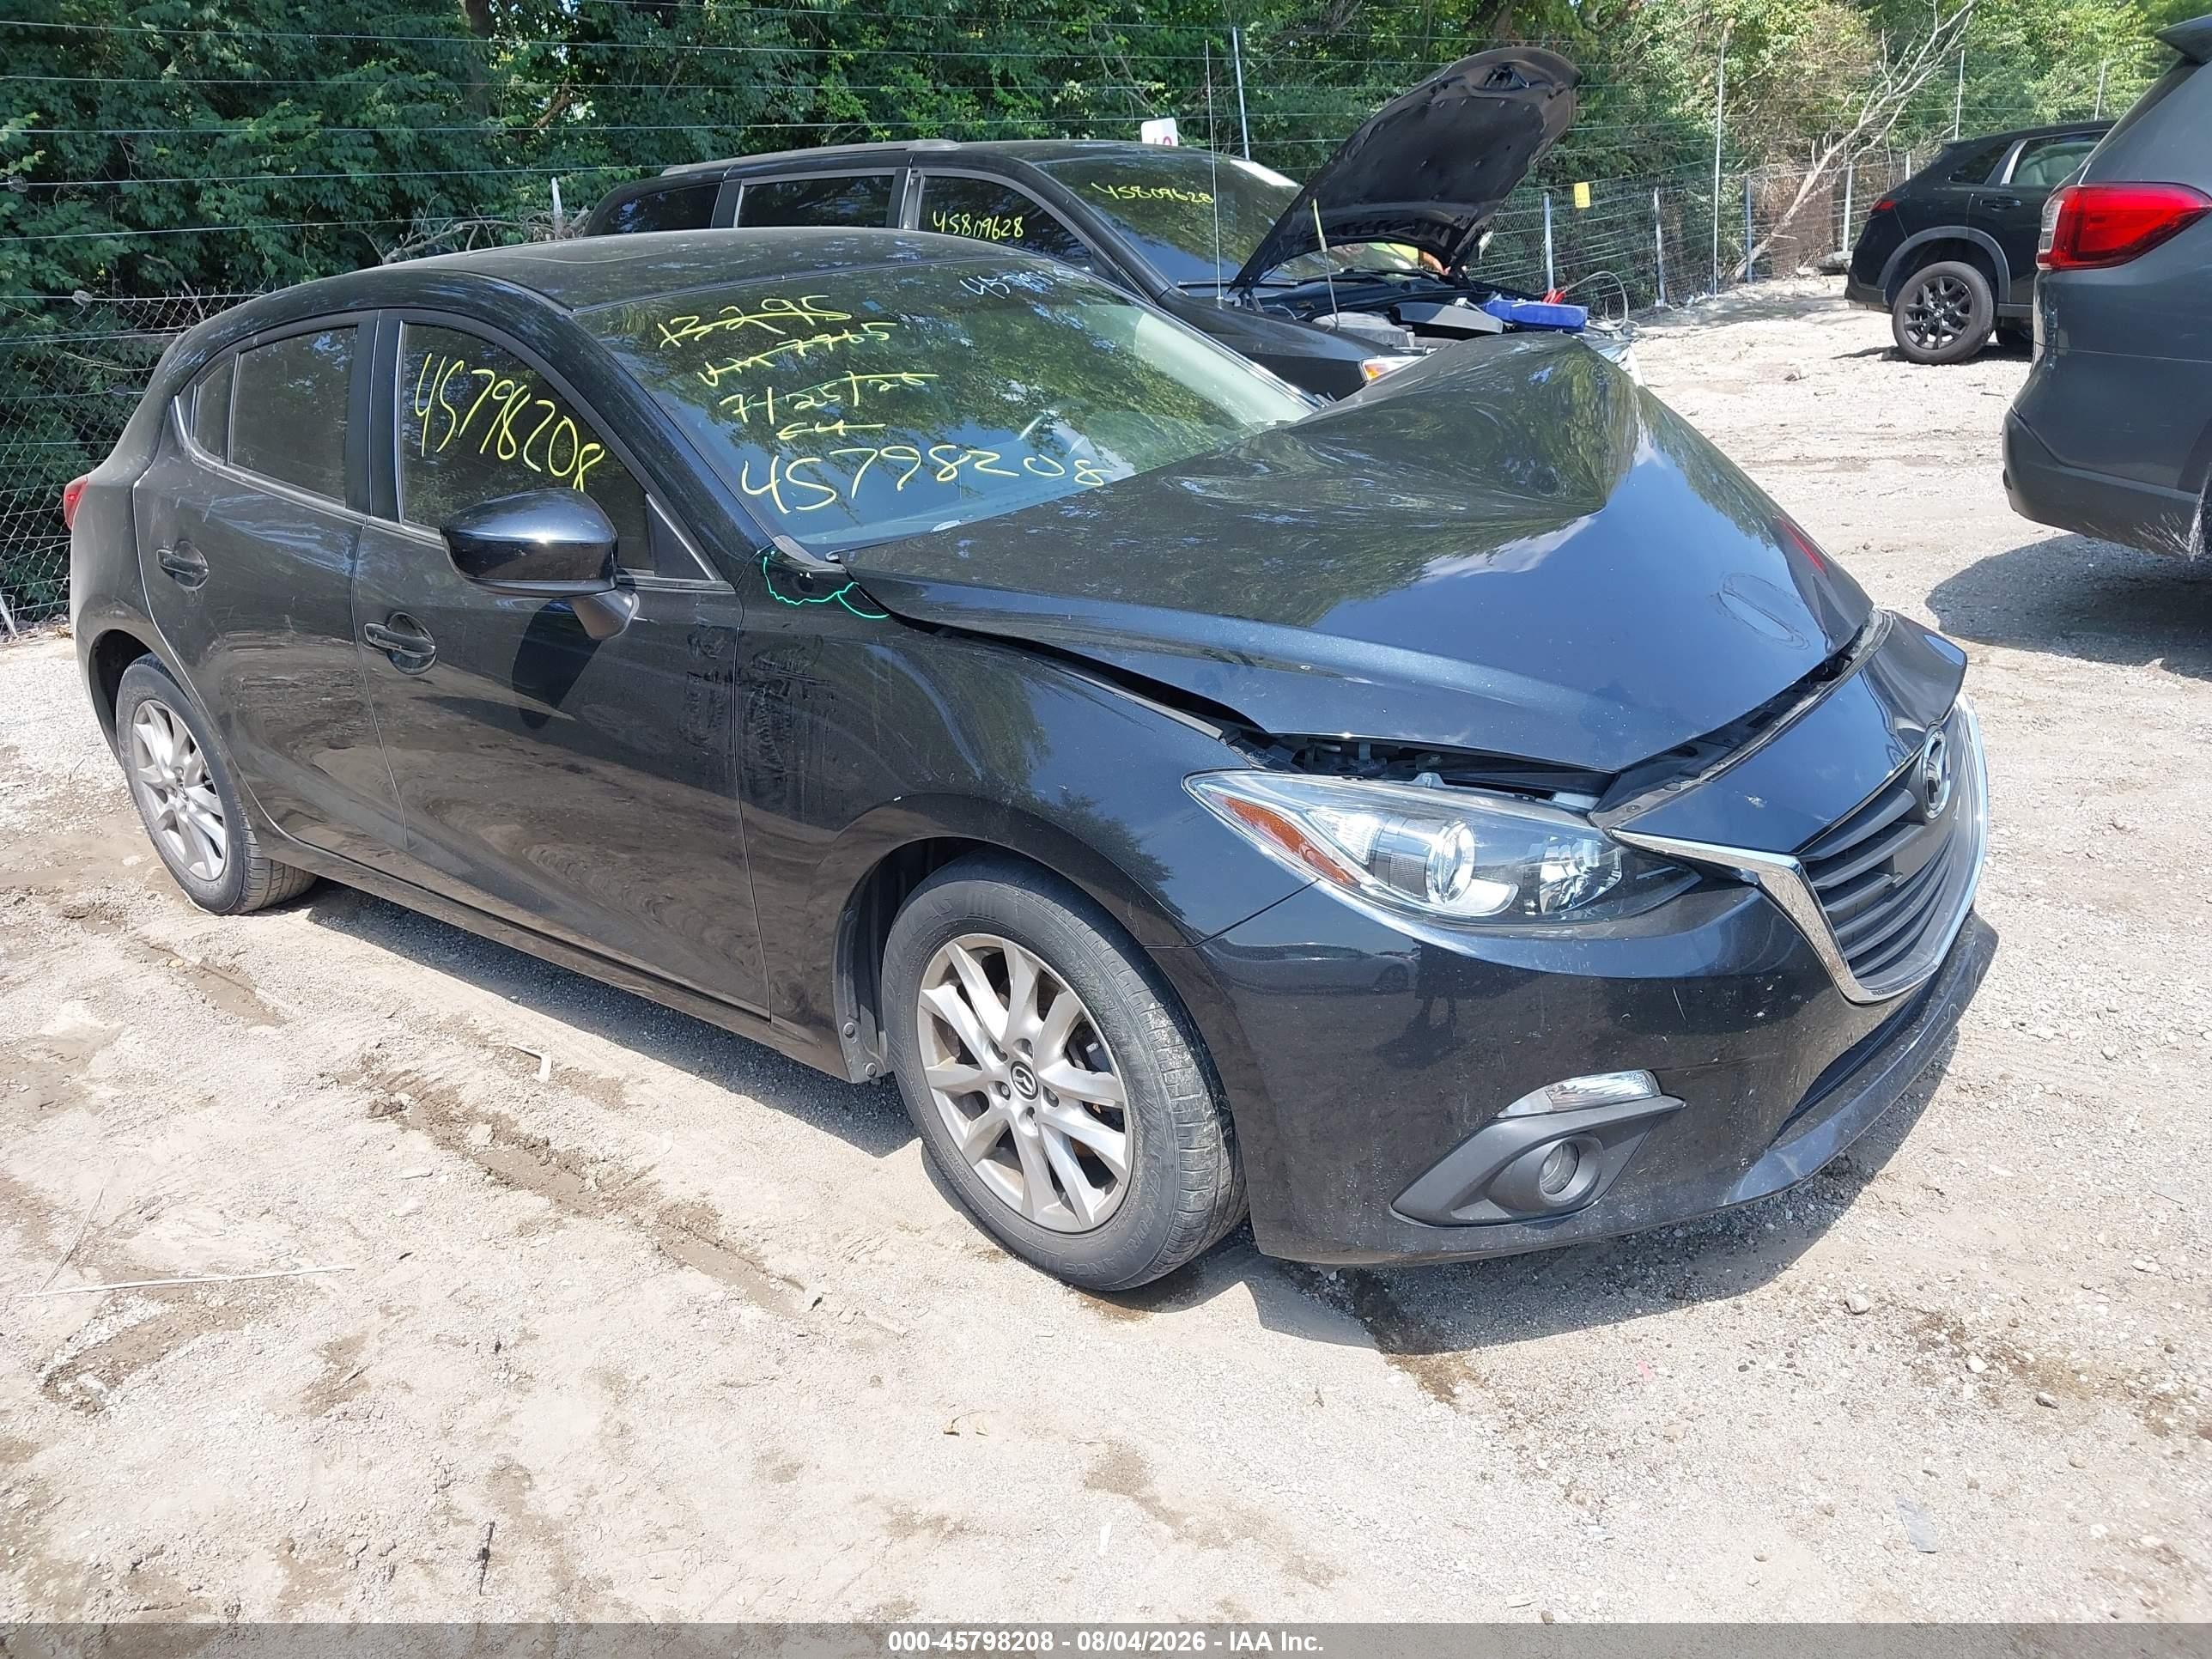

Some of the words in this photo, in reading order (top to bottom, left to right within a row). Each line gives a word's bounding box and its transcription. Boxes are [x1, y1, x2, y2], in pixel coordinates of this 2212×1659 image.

[933, 210, 1024, 240] 45809628
[415, 352, 605, 494] 45798208
[741, 445, 1114, 514] 45798208
